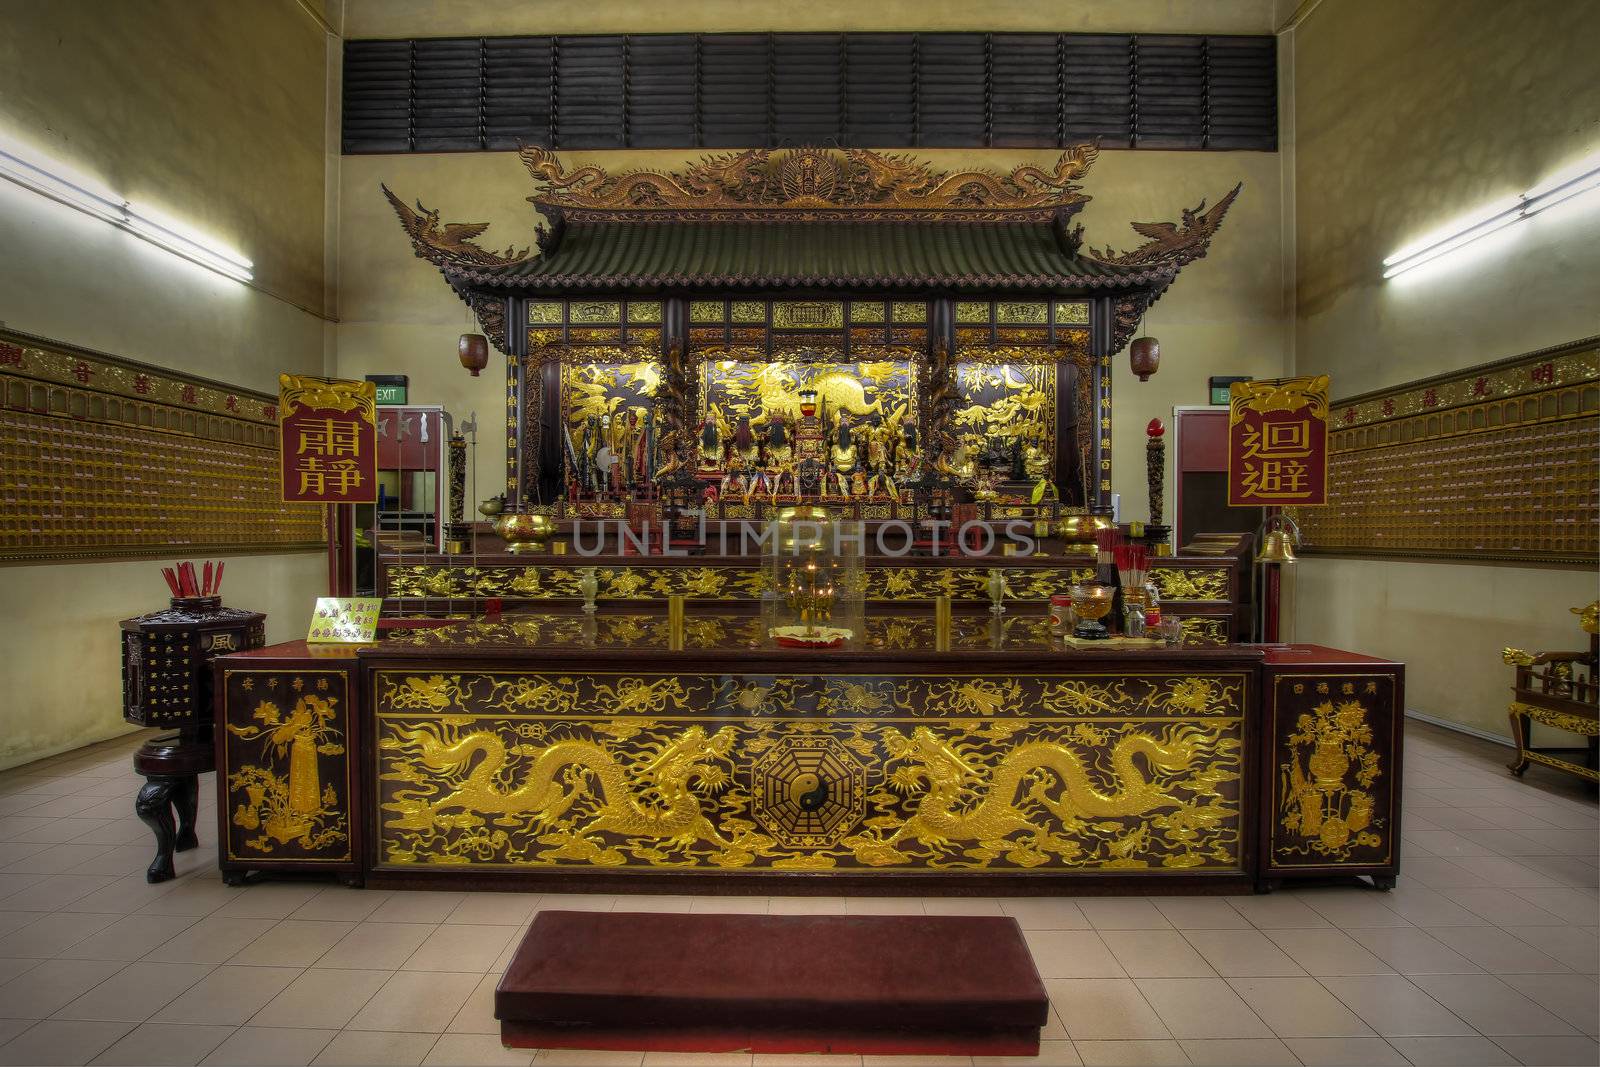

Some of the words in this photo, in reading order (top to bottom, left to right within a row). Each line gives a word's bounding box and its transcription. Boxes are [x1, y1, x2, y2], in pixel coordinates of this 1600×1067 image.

[376, 389, 397, 401] EXIT
[294, 418, 366, 496] 肅靜
[1240, 419, 1314, 498] 迴避
[207, 634, 237, 651] 風
